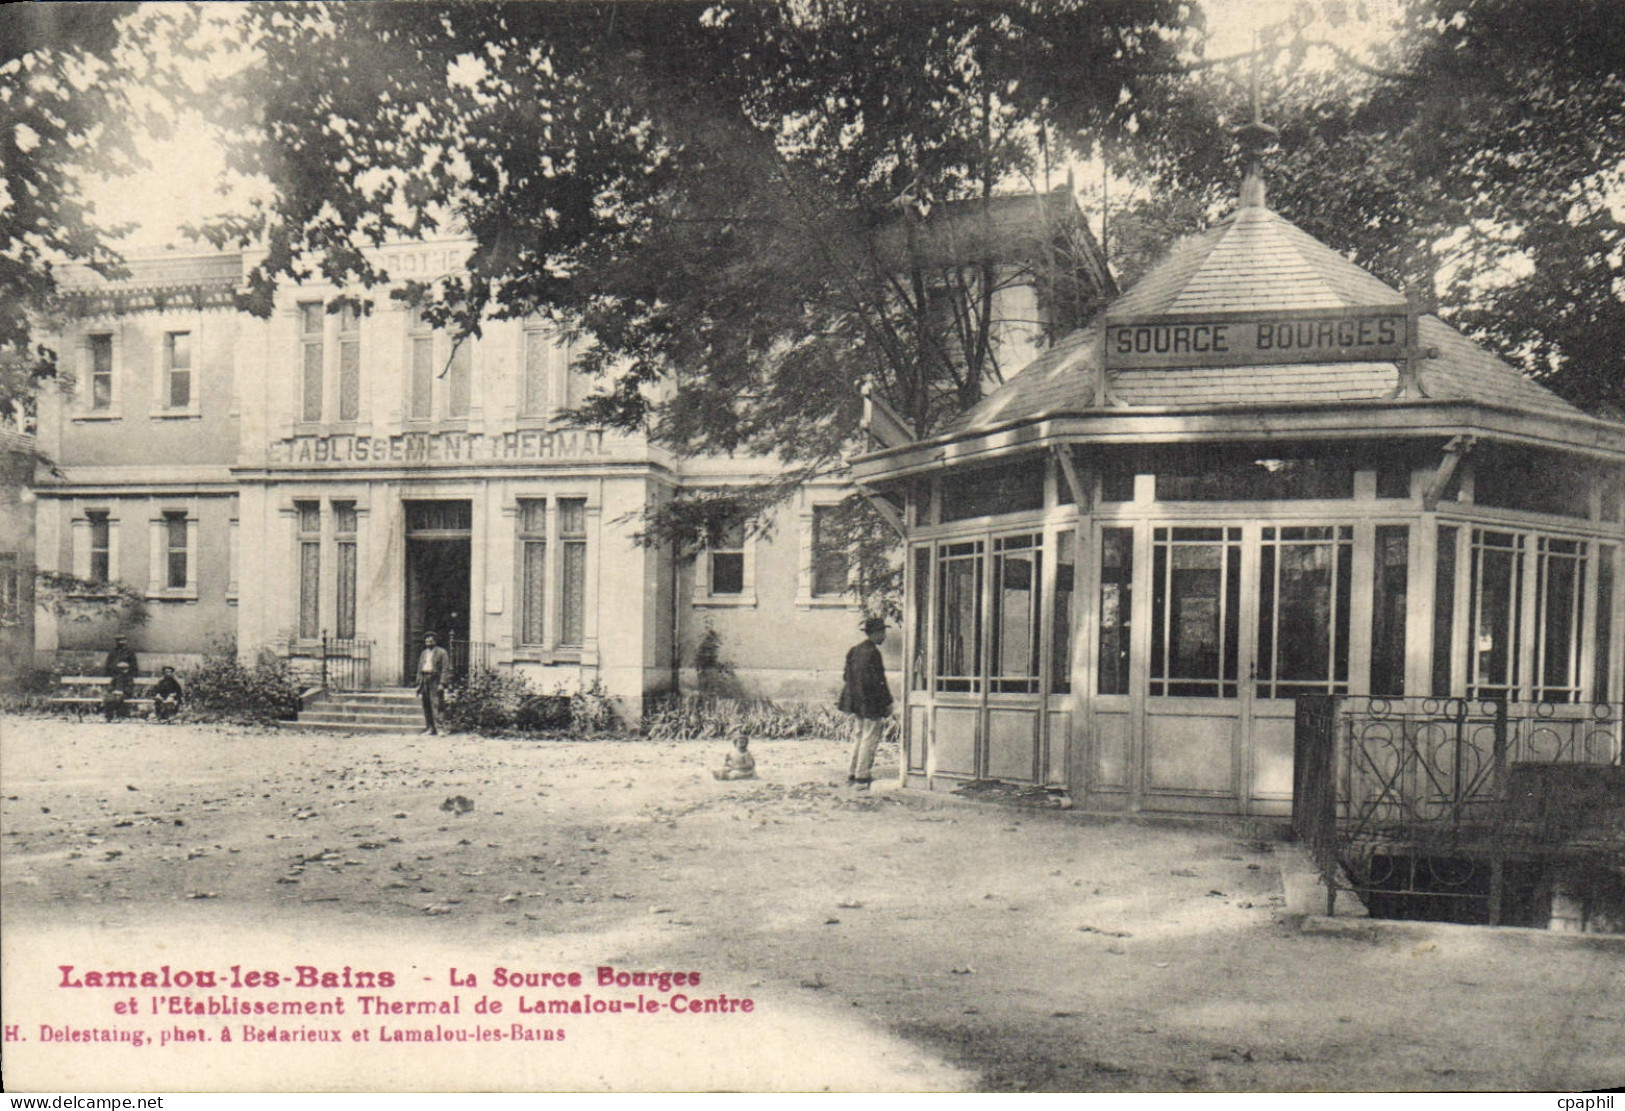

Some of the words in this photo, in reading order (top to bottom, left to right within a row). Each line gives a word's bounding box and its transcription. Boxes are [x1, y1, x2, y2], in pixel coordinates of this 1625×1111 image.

[1117, 325, 1229, 353] SOURCE
[1256, 318, 1397, 351] BOURGES
[489, 431, 612, 459] THERMAL
